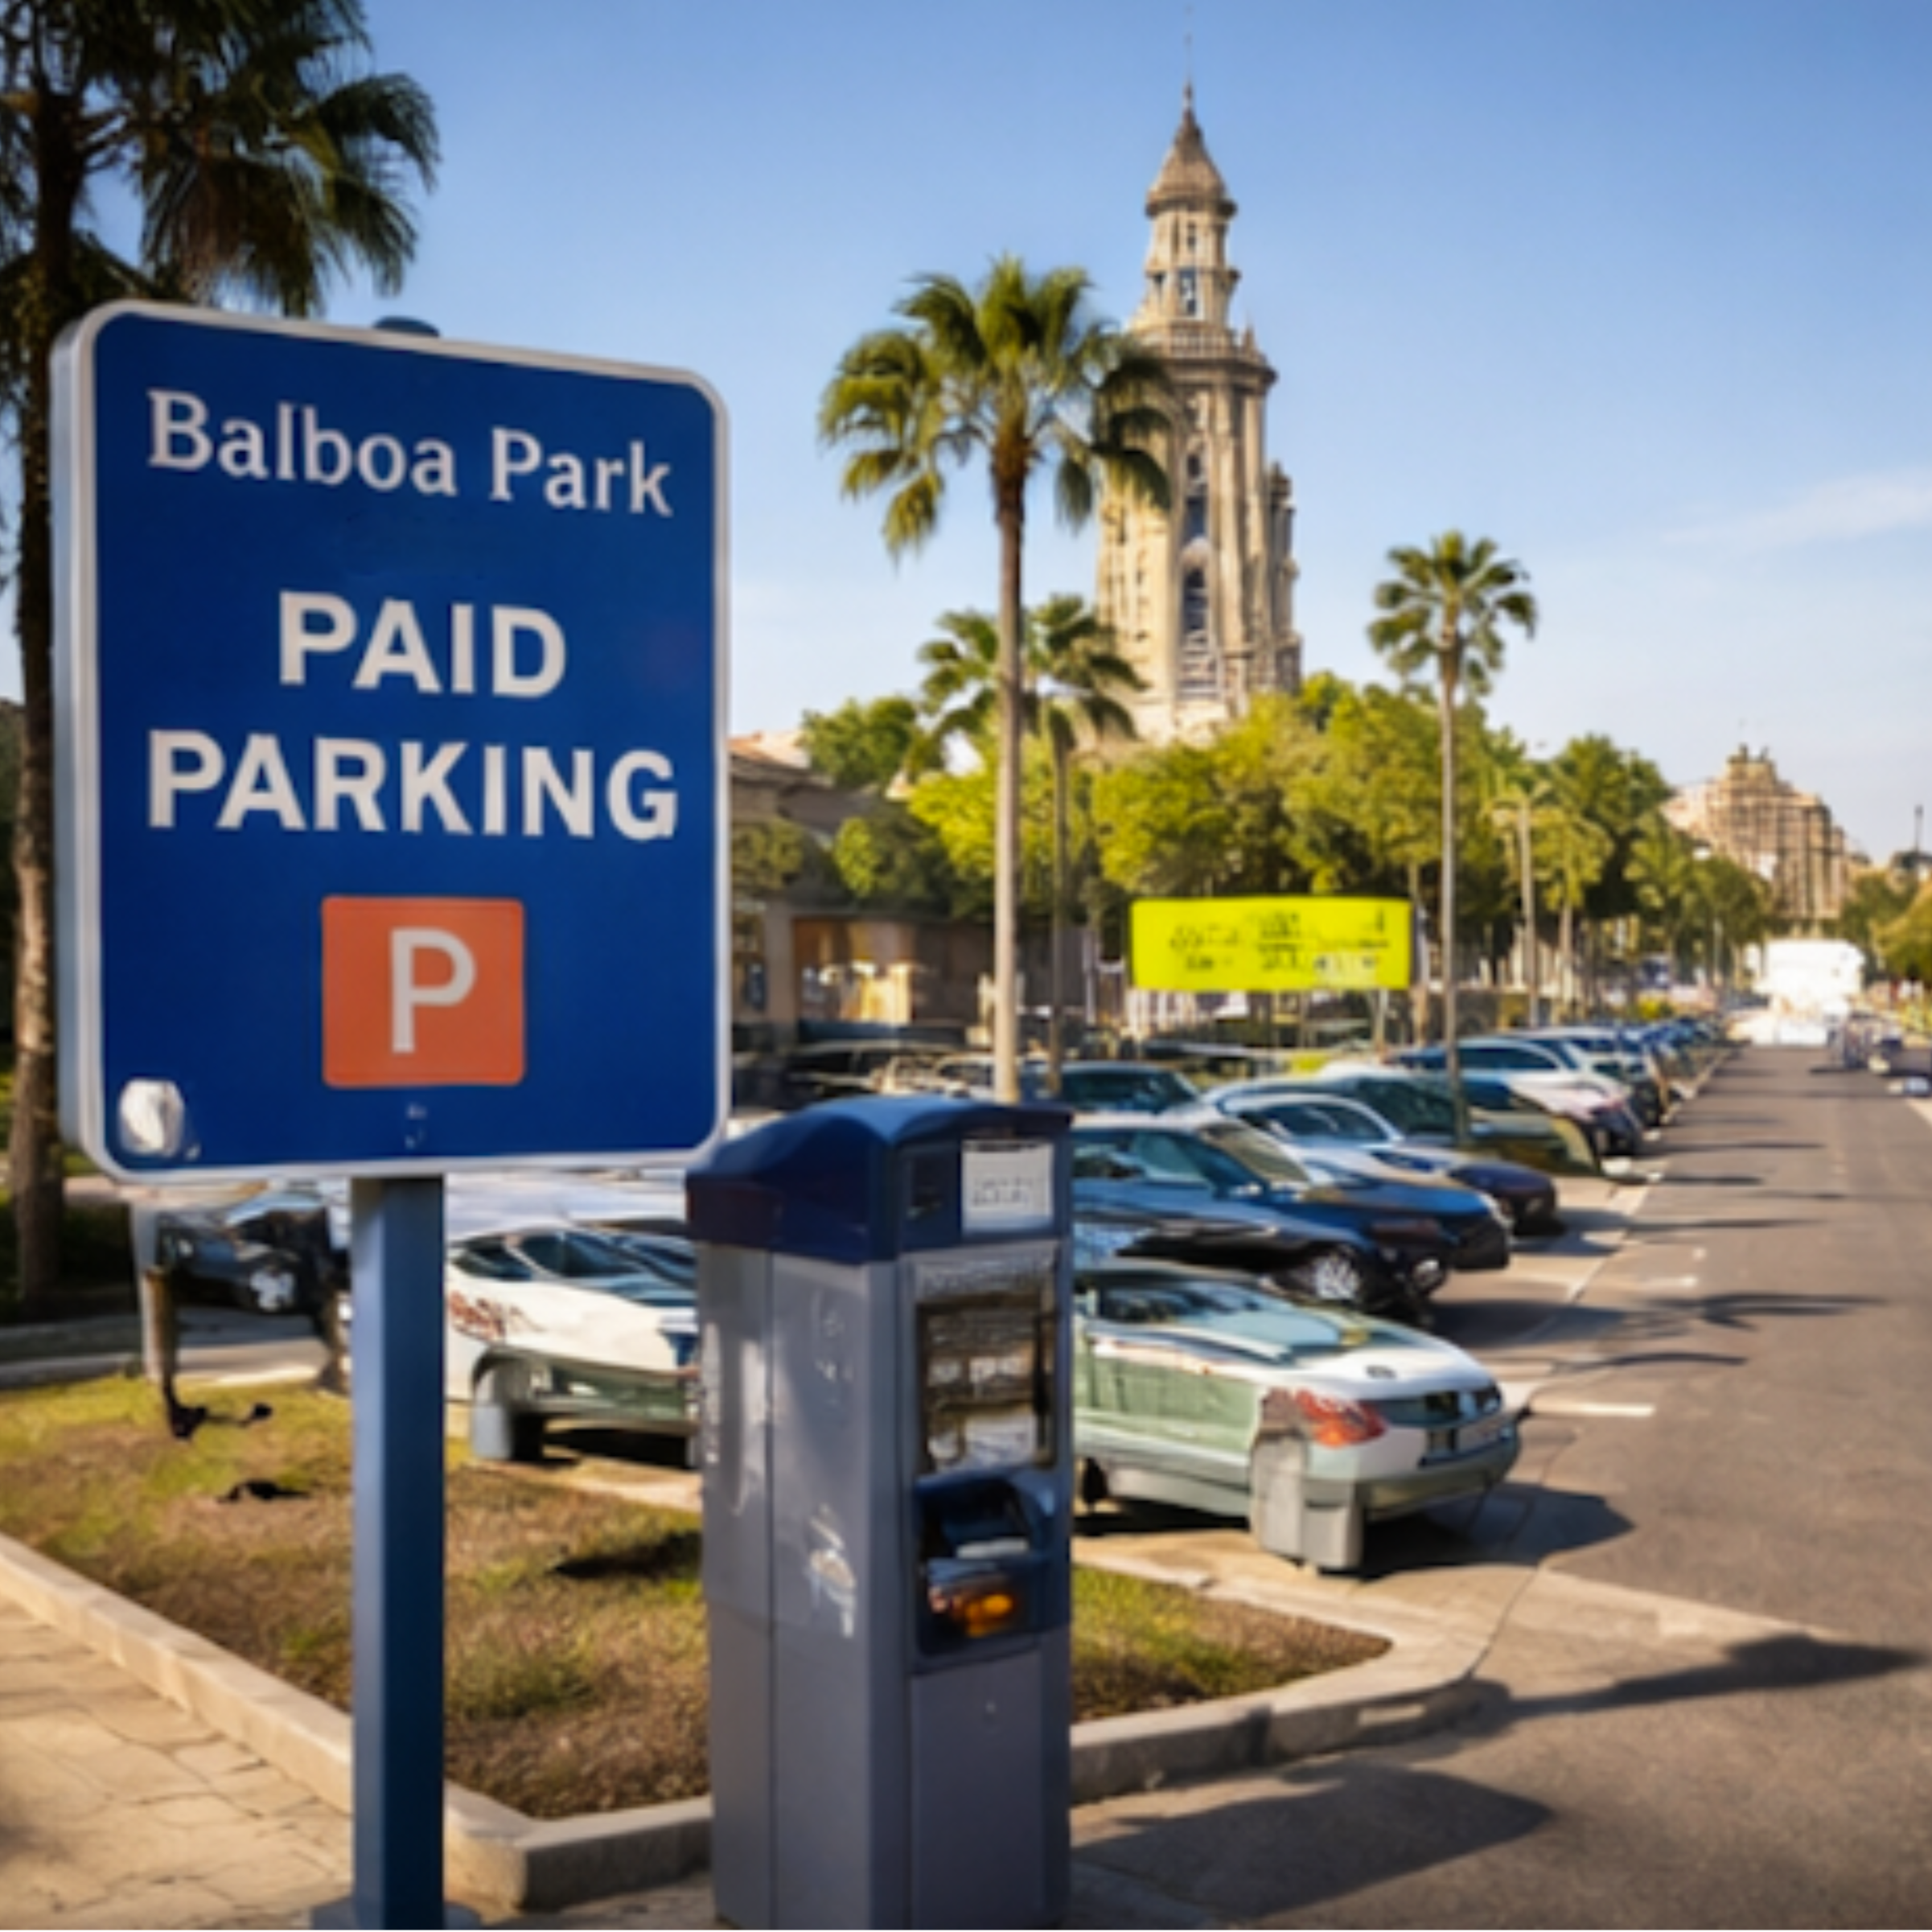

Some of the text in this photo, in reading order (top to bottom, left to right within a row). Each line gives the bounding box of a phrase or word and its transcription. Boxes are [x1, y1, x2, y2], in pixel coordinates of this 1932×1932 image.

[150, 391, 672, 516] Balboa Park
[278, 590, 567, 699] PAID
[149, 730, 679, 842] PARKING
[389, 926, 478, 1055] P
